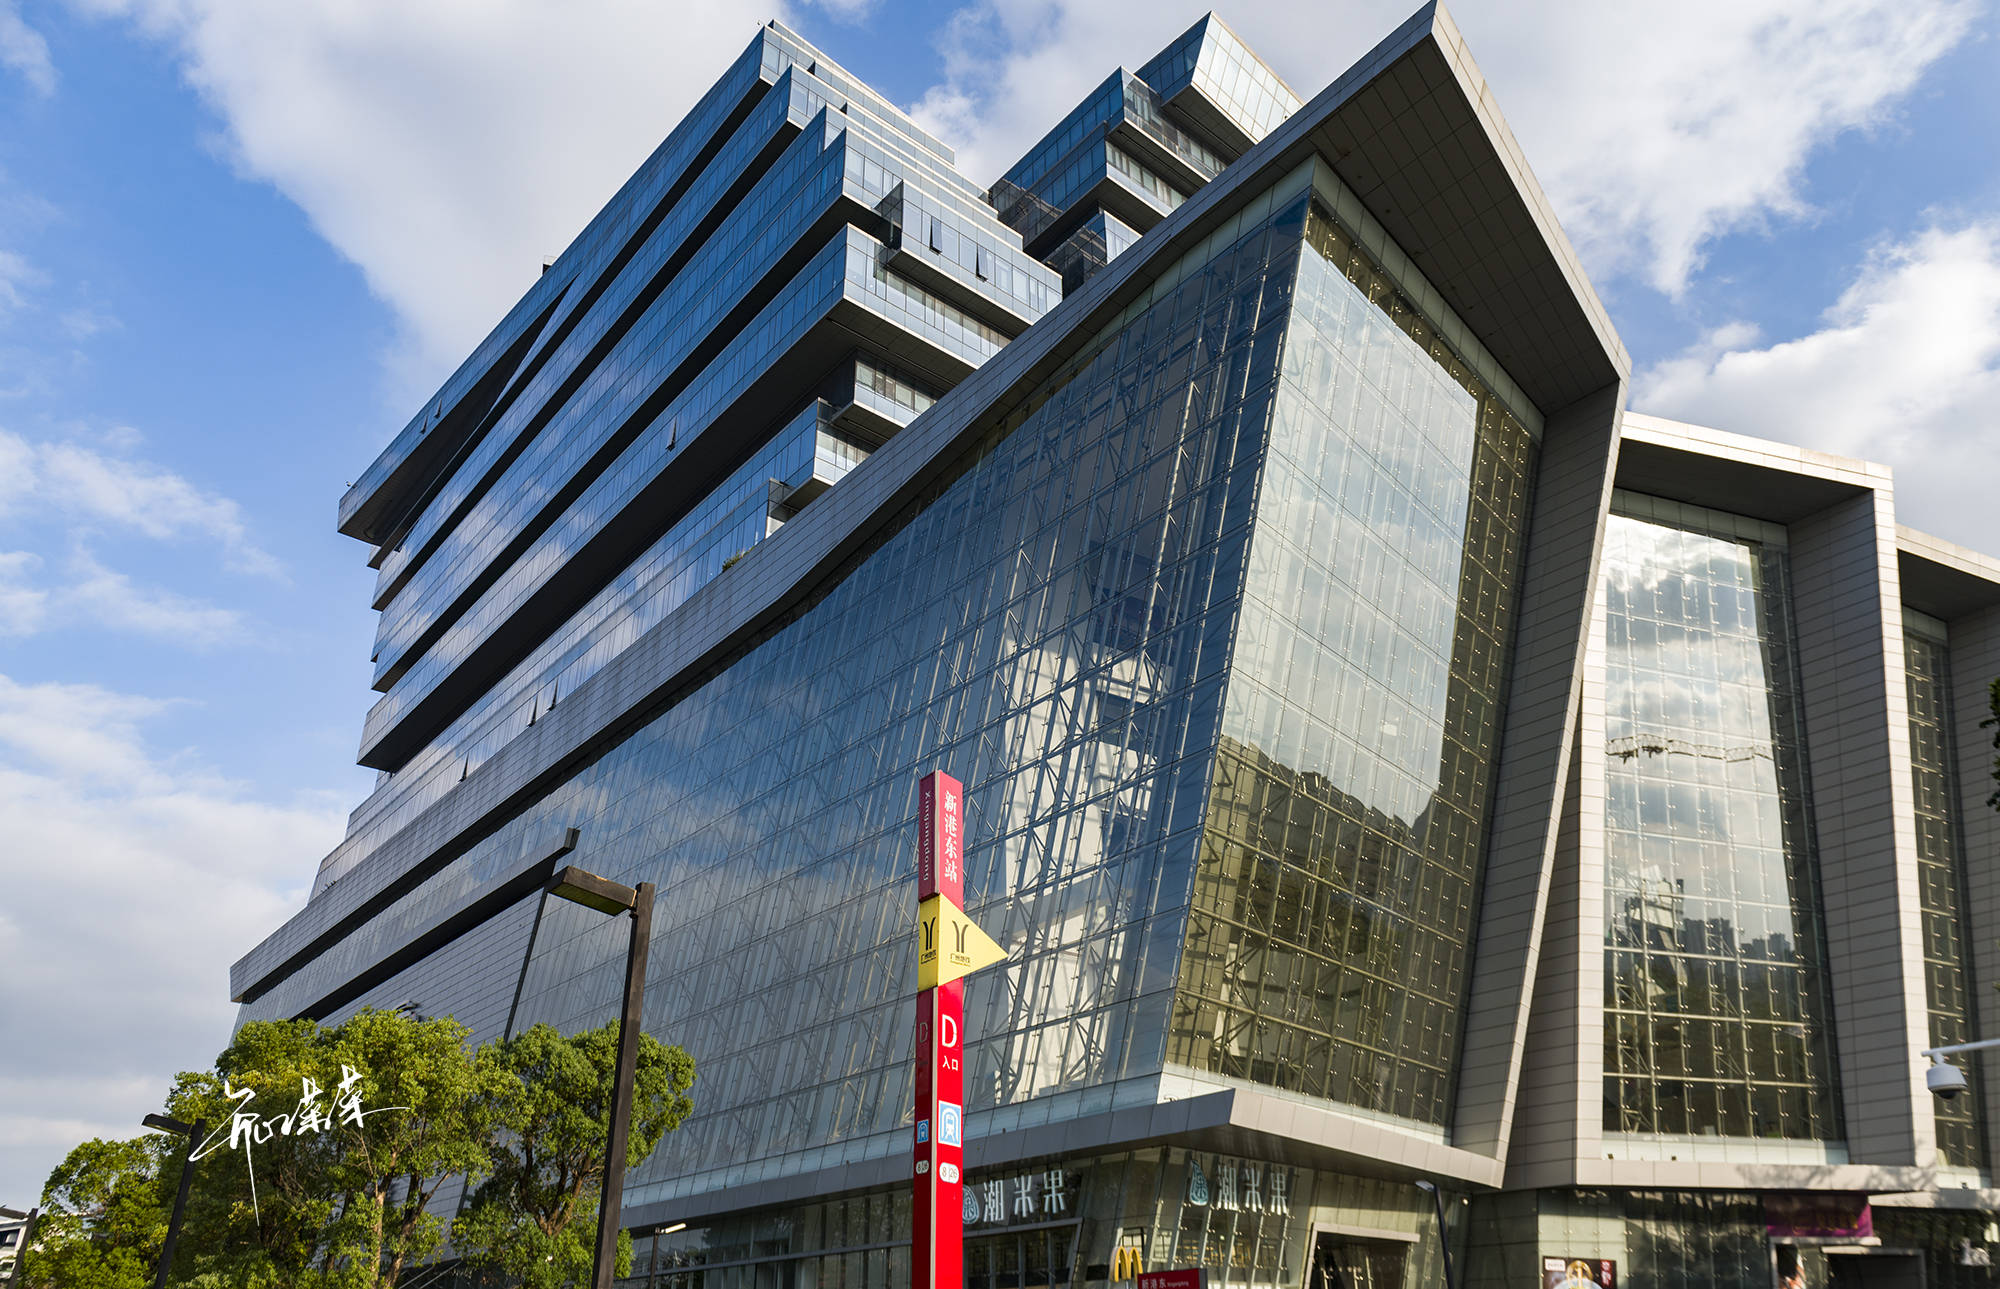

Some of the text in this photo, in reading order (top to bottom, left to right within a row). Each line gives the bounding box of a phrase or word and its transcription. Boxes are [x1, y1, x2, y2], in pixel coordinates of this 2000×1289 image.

[944, 790, 957, 883] 新港东站
[919, 1022, 929, 1043] D
[942, 1014, 957, 1048] D
[942, 1055, 959, 1071] 入口
[983, 1169, 1065, 1222] 潮米果
[1217, 1164, 1287, 1215] 潮米果
